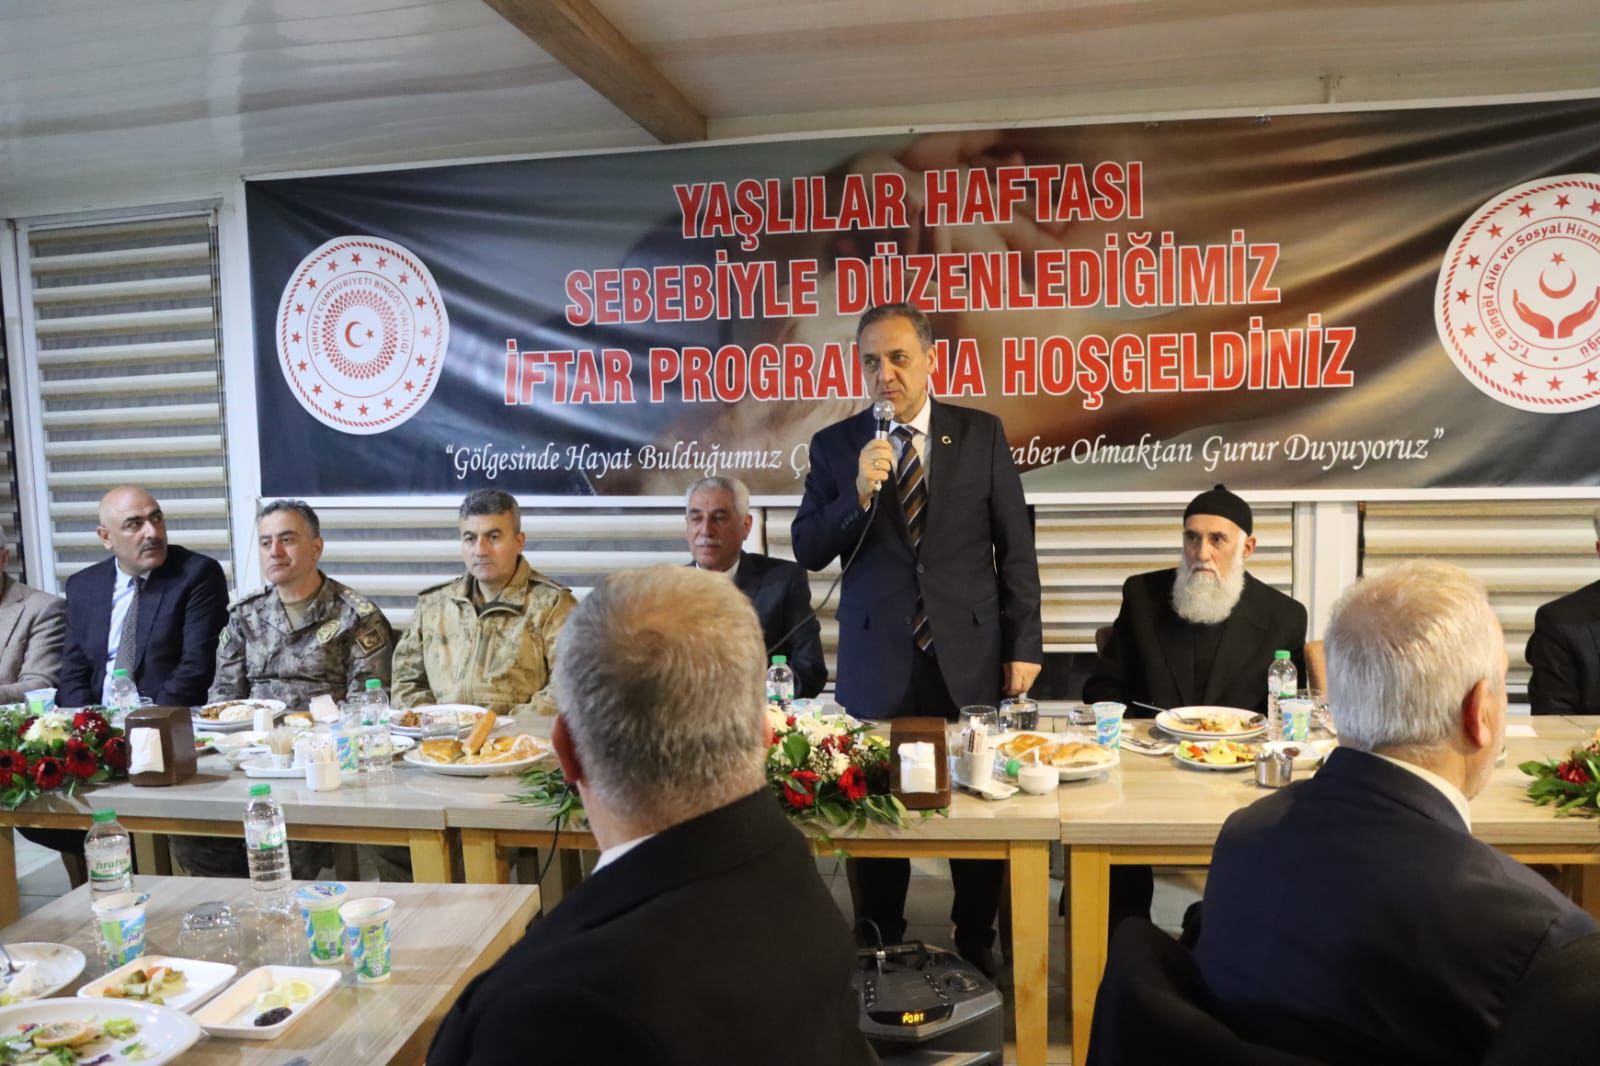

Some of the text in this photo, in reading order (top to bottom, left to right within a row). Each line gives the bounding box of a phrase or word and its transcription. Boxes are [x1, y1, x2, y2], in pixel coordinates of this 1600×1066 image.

[673, 161, 1144, 251] YAŞLILAR HAFTASI
[1500, 244, 1515, 260] ve
[1516, 222, 1562, 247] Sosyal
[565, 228, 1282, 326] SEBEBİYLE DÜZENLEDİĞİMİZ
[1484, 263, 1502, 290] Aile
[1482, 295, 1507, 340] Bingöl
[504, 338, 637, 406] İFTAR
[1002, 313, 1357, 410] HOŞGELDİNİZ
[564, 443, 632, 478] Hayat
[638, 440, 782, 478] Bulduğumuz
[1070, 433, 1194, 470] Olmaktan
[1202, 434, 1280, 471] Gurur
